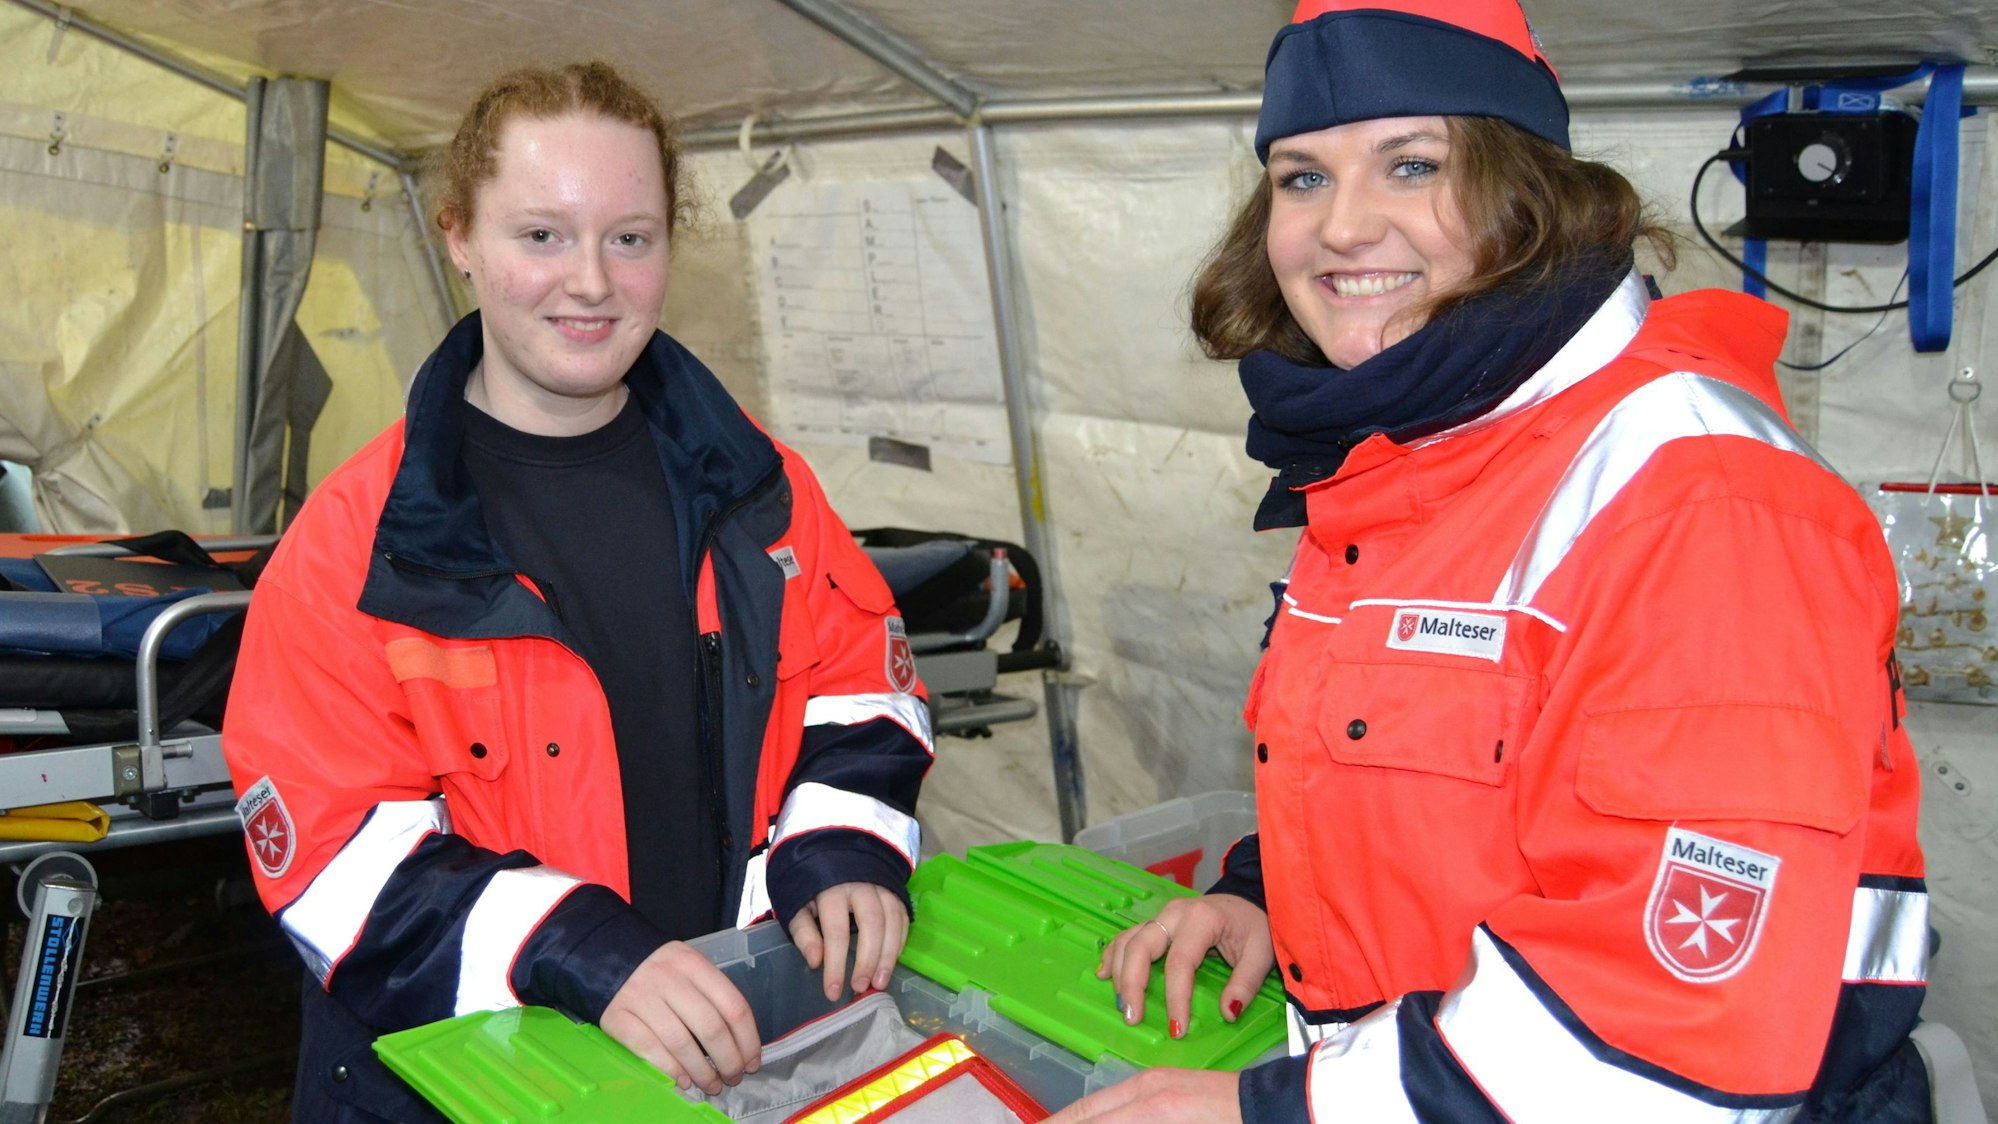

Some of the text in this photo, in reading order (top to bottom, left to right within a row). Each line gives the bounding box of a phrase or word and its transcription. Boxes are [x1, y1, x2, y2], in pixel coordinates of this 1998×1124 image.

[1420, 617, 1497, 641] Malteser
[1672, 837, 1768, 881] Malteser
[29, 916, 65, 1035] STOLLENWERK
